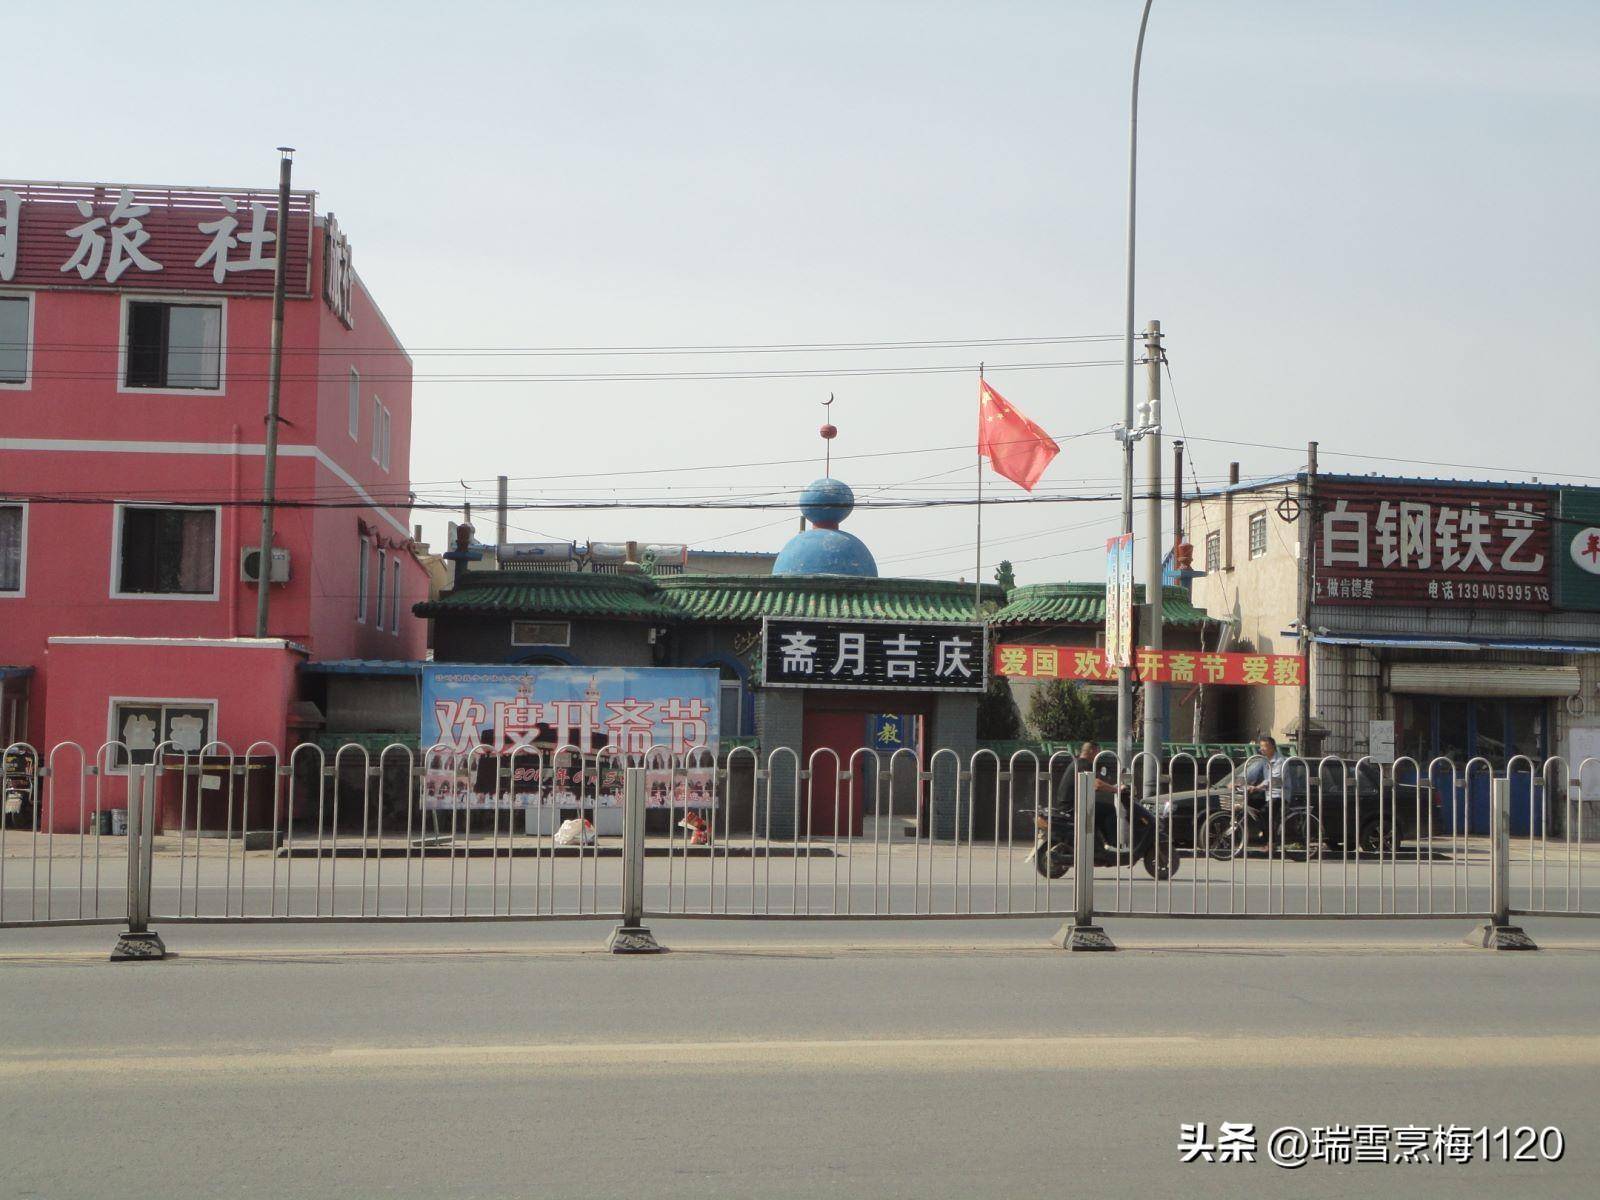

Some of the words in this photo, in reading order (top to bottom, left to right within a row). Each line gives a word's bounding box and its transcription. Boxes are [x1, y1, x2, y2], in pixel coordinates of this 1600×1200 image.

[1323, 499, 1545, 572] 白钢铁艺
[1428, 579, 1454, 600] 电话
[1458, 583, 1550, 601] 13940599518
[780, 631, 972, 678] 斋月吉庆
[1000, 647, 1058, 677] 爱国
[1074, 651, 1228, 683] 欢开斋节
[1242, 656, 1301, 685] 爱教
[434, 696, 711, 755] 欢度开斋节
[877, 713, 901, 744] 教
